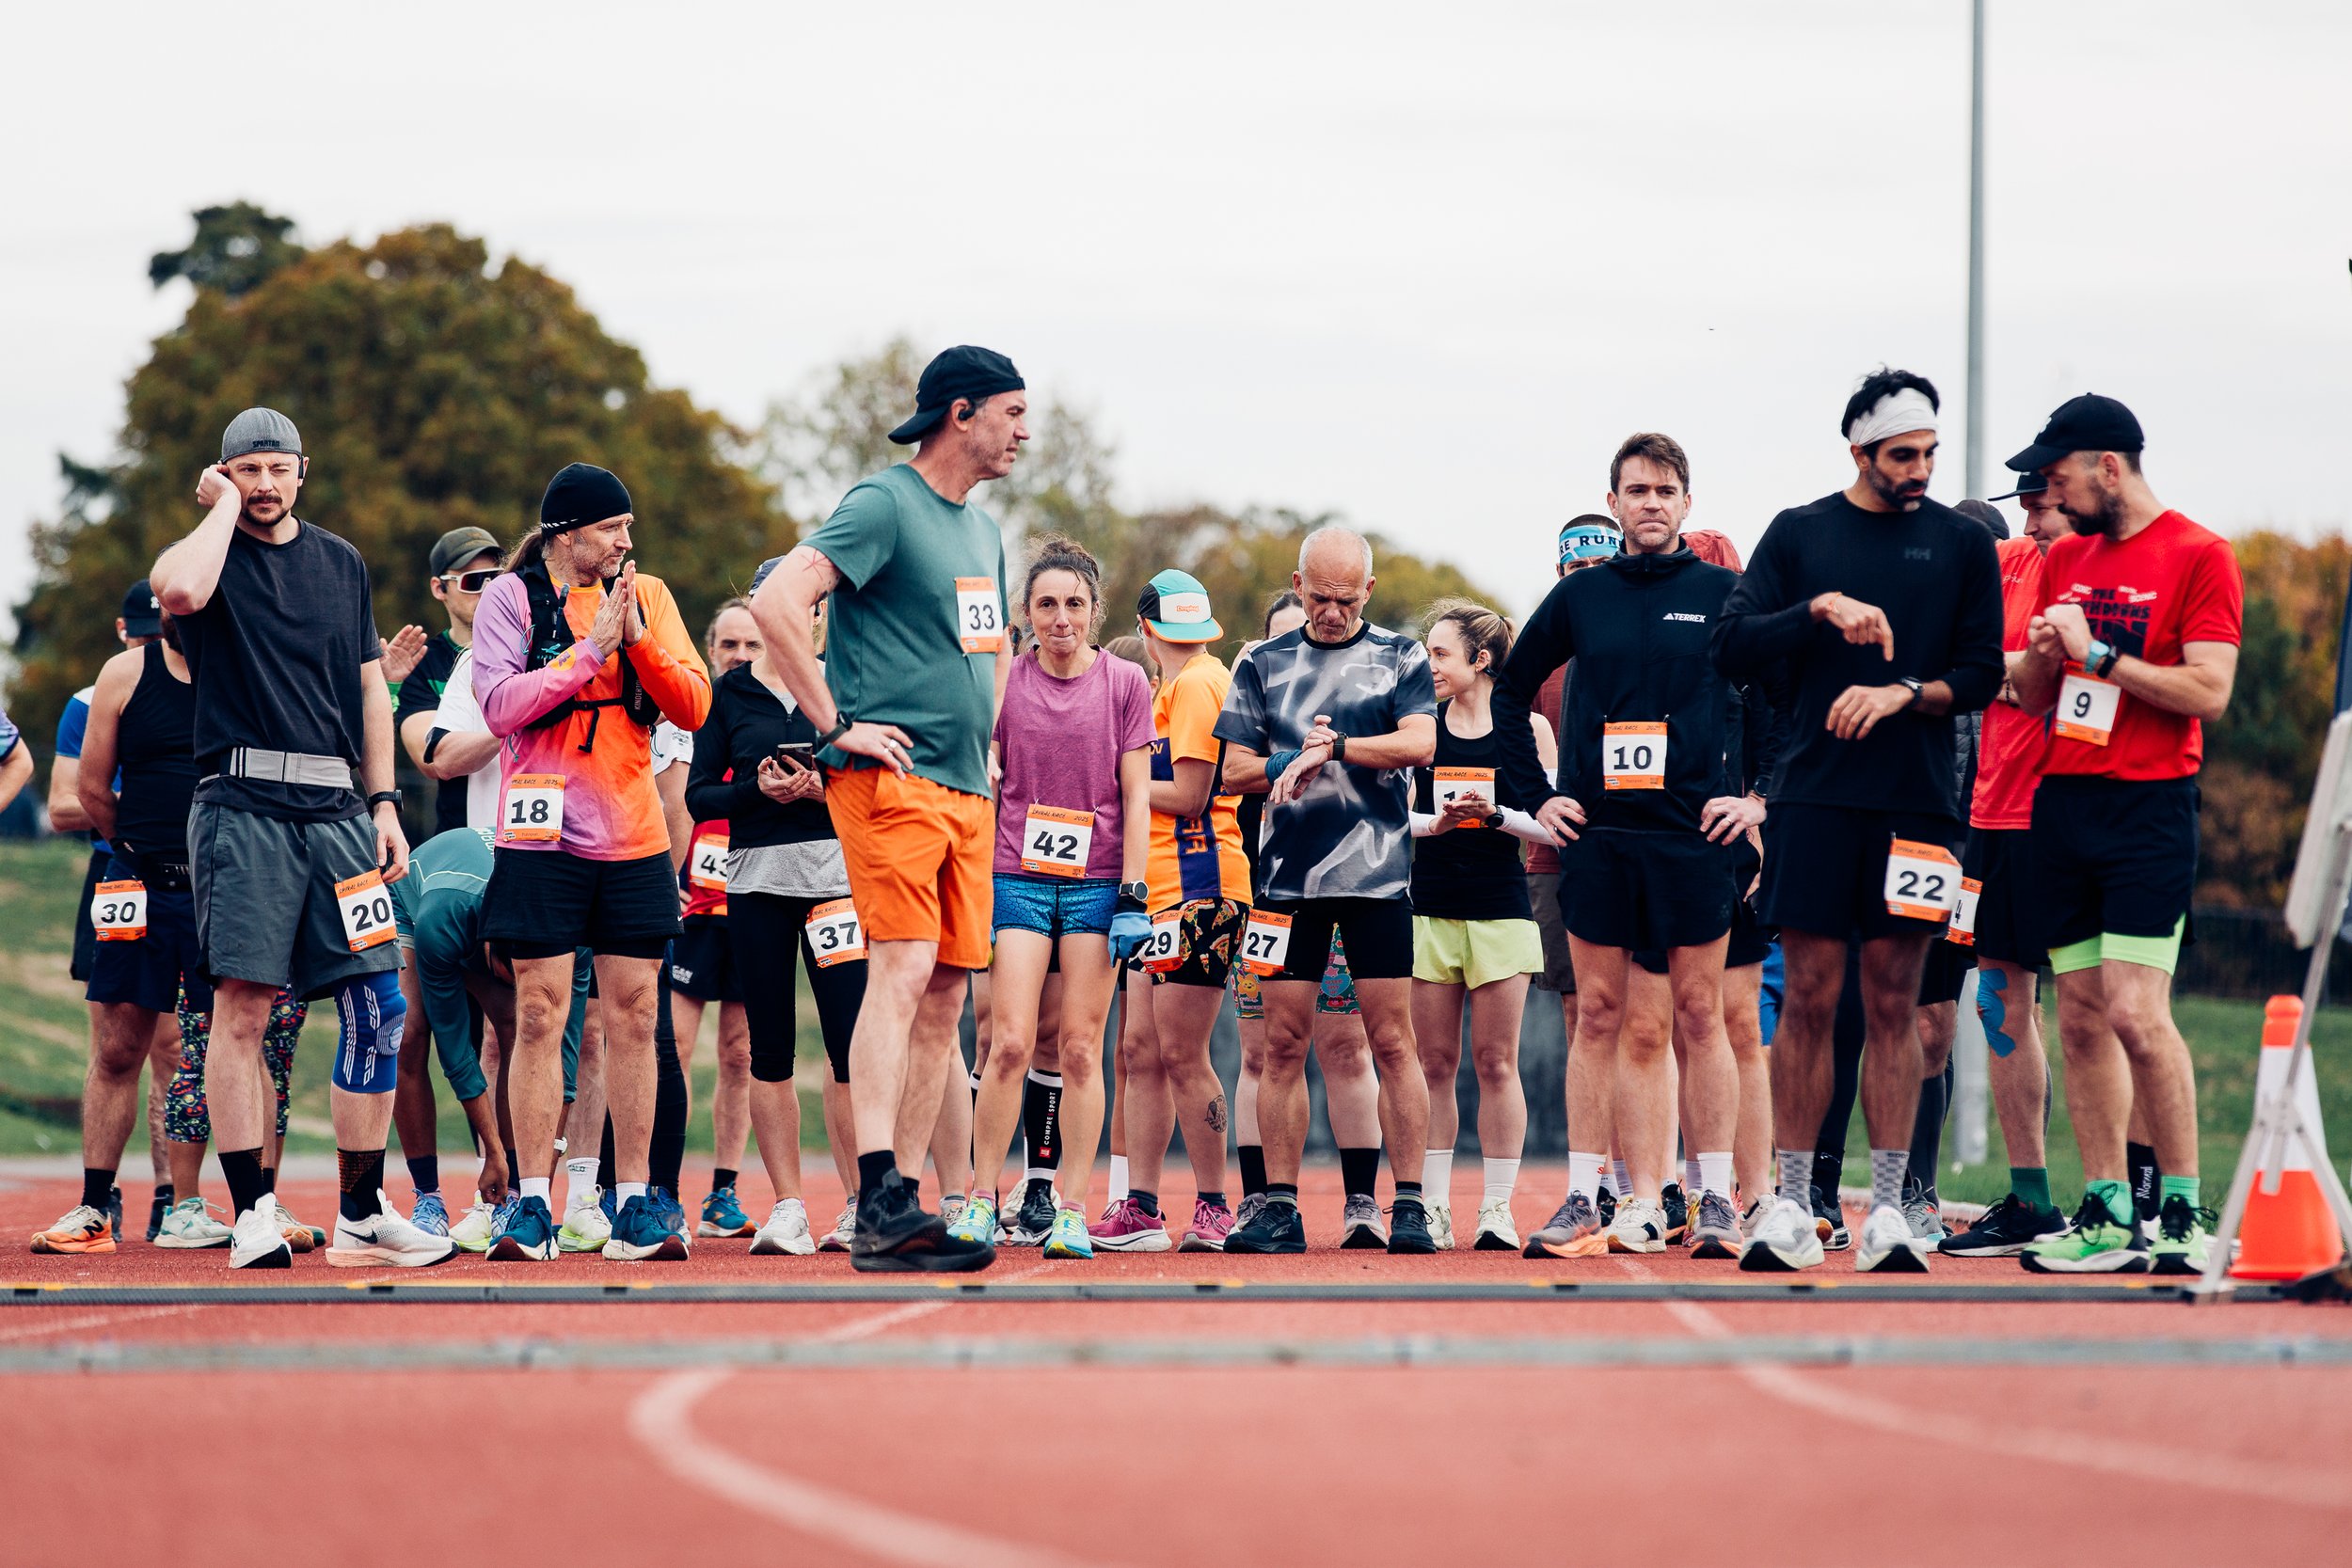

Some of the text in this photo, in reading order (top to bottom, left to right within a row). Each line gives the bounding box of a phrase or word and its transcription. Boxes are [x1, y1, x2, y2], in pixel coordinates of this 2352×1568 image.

[969, 604, 995, 631] 33
[1674, 612, 1706, 624] TERREX
[2074, 691, 2091, 719] 9
[1613, 745, 1652, 770] 10
[511, 799, 548, 824] 18
[1033, 831, 1078, 861] 42
[1897, 870, 1945, 902] 22
[101, 901, 136, 924] 30
[352, 897, 390, 932] 20
[818, 921, 858, 950] 37
[1144, 931, 1172, 958] 29
[1247, 931, 1279, 958] 27
[1043, 1092, 1057, 1146] COMPRESSPORT
